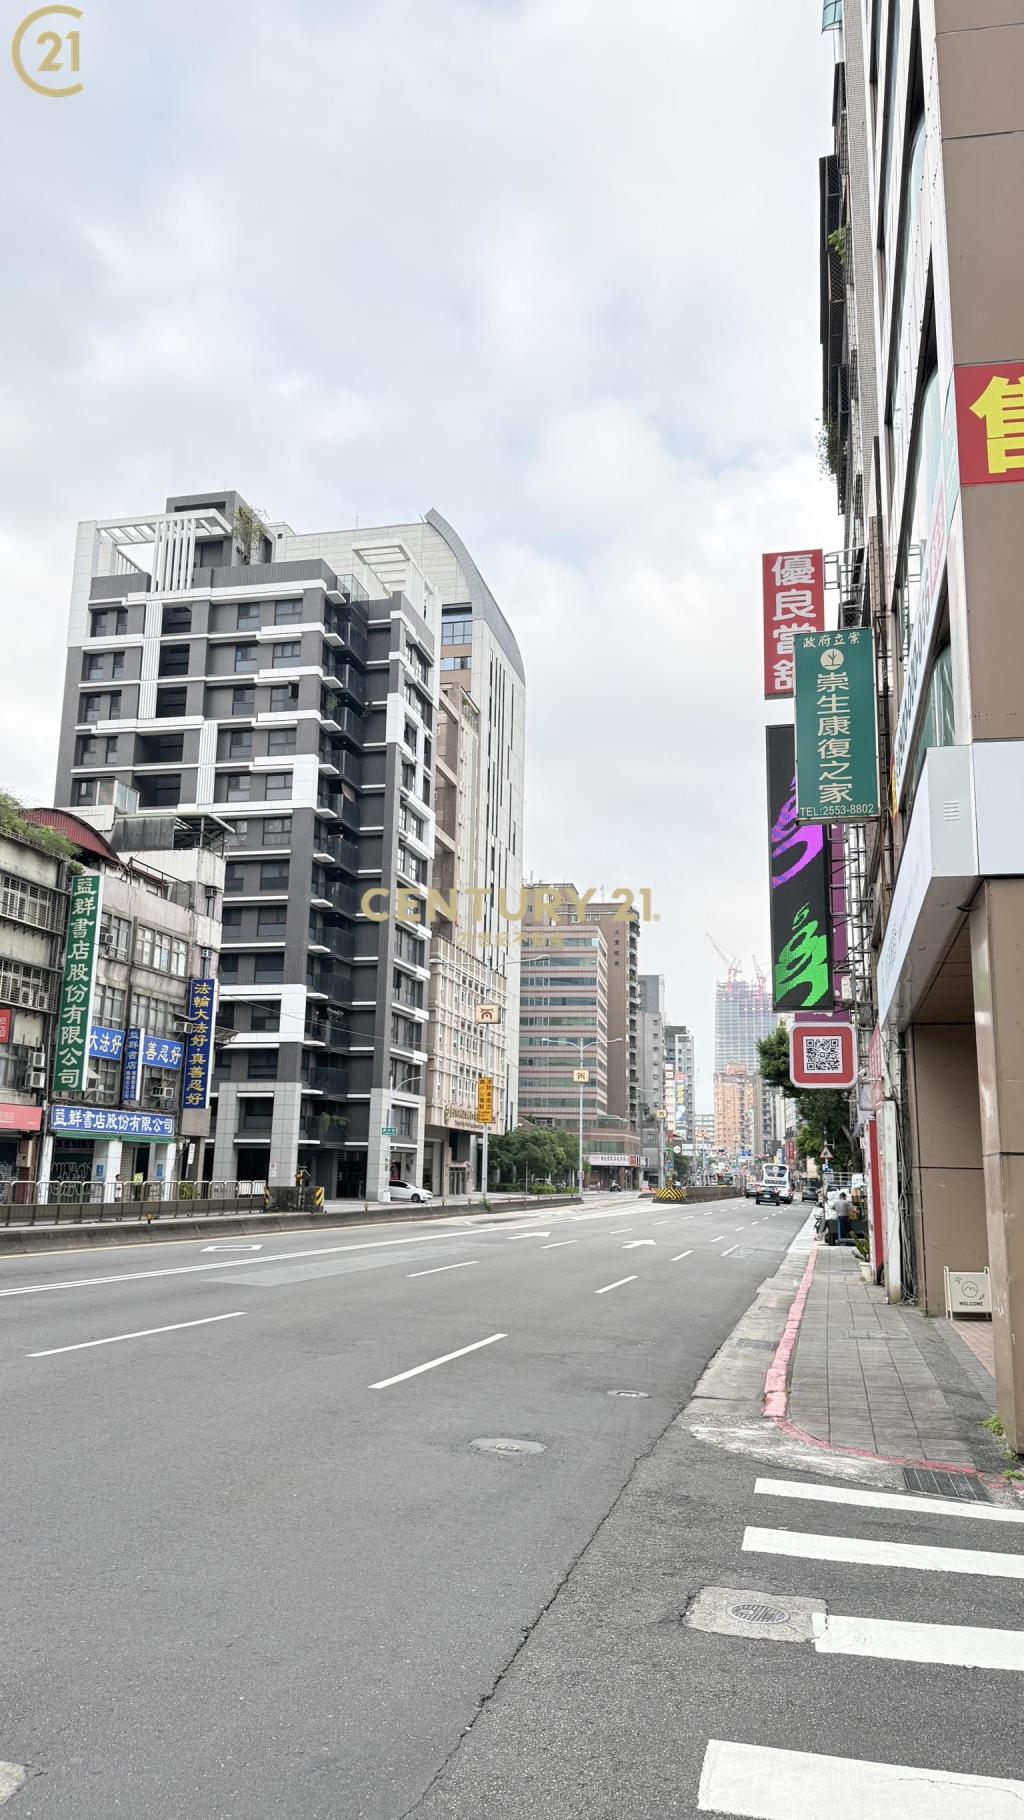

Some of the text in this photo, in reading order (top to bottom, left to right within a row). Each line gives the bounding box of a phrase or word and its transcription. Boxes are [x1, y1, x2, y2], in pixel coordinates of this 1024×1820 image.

[816, 671, 853, 804] 崇生康復之家
[799, 803, 874, 817] TEL:2553-8802
[58, 878, 97, 1089] 益群書店股份有限公司
[143, 1040, 182, 1065] 善忍好
[53, 1108, 173, 1133] 益群書店股份有限公司
